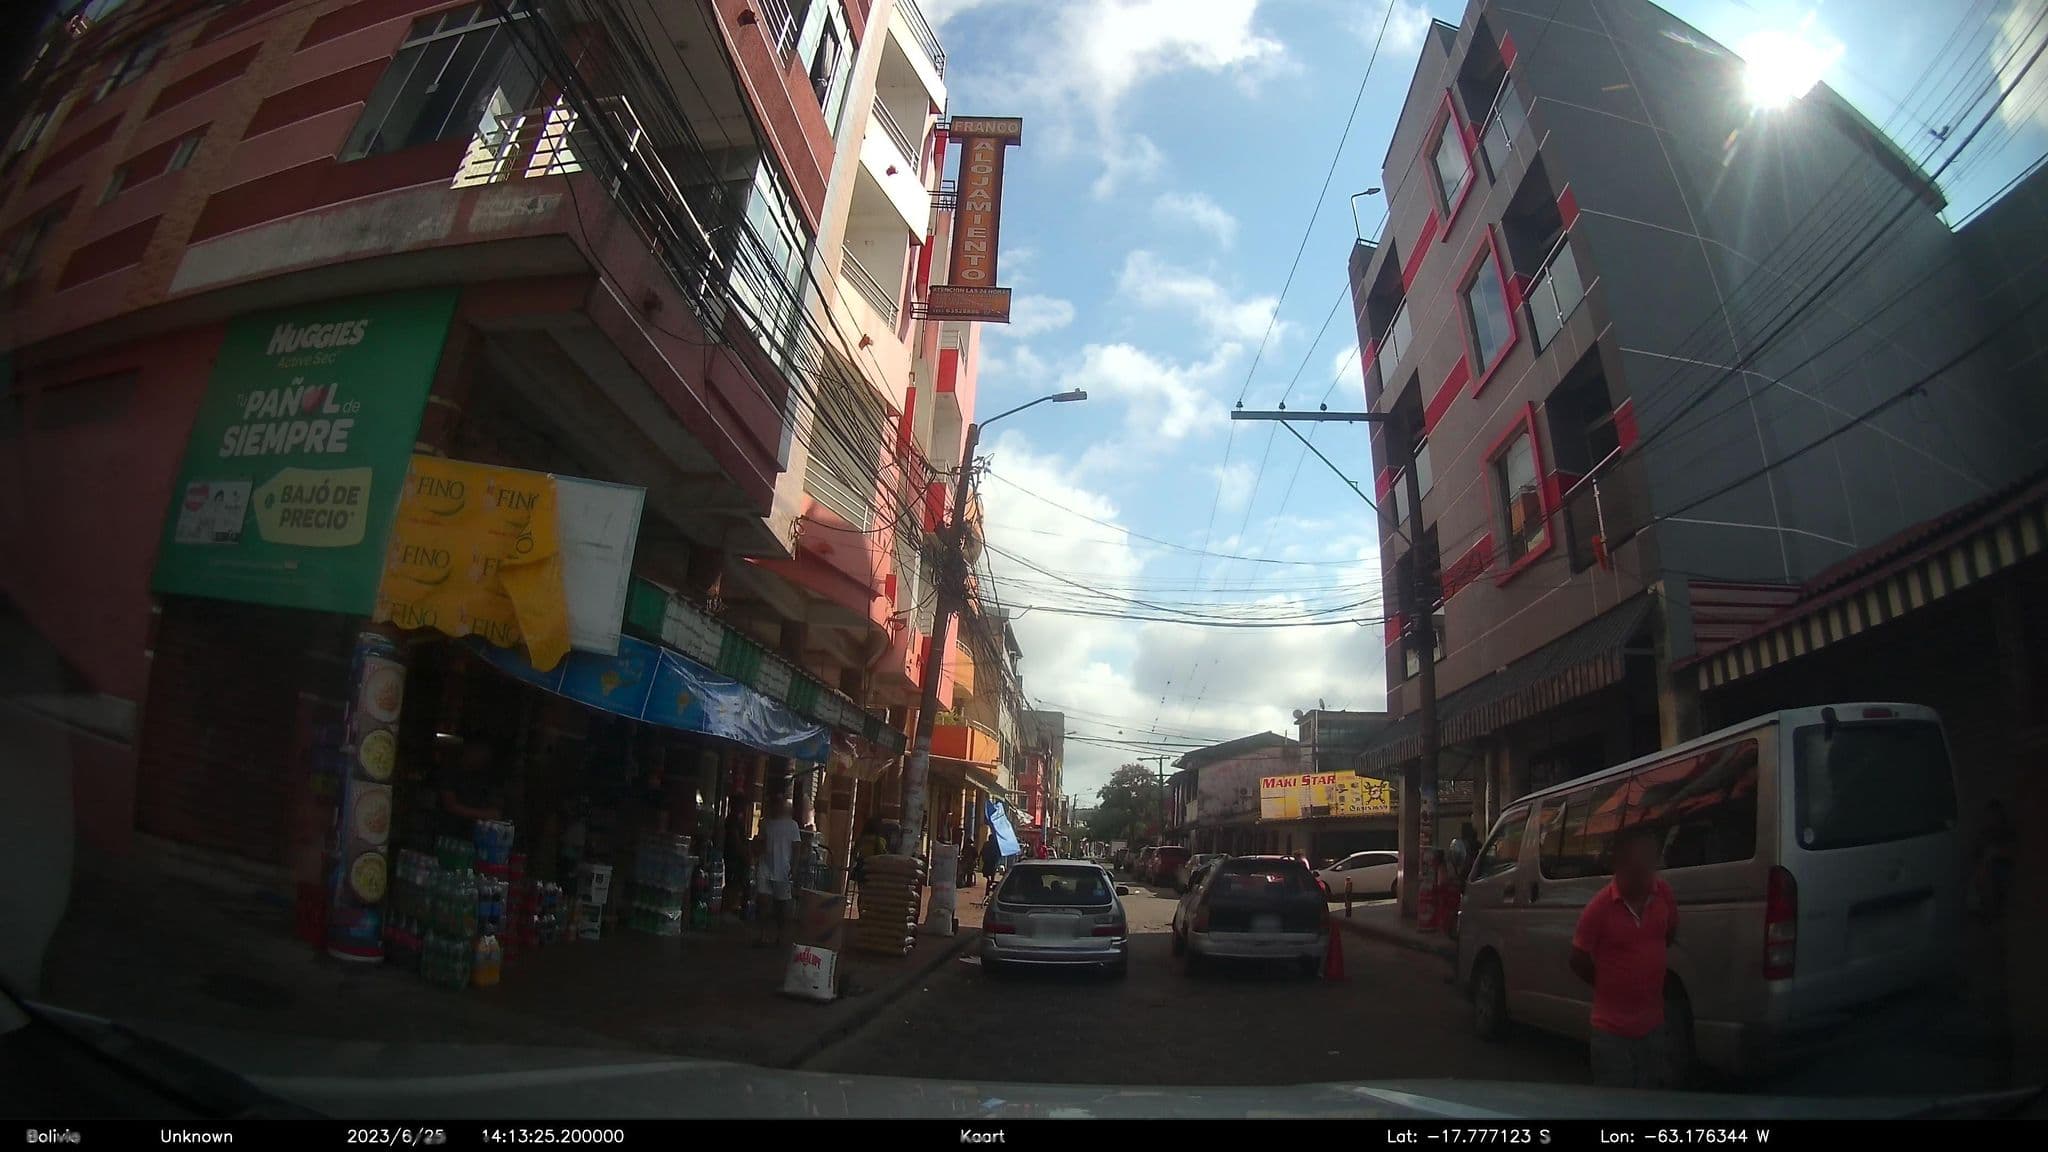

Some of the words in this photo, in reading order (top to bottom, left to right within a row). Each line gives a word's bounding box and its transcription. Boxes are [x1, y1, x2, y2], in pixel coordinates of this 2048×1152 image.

[953, 120, 1019, 134] FRANCO
[961, 140, 994, 280] ALOJAMIENTO
[265, 318, 369, 356] HUGGIES
[342, 398, 361, 414] de
[218, 418, 355, 458] SIEMPRE
[279, 477, 331, 506] BAJÓ
[332, 485, 362, 506] DE
[417, 476, 465, 501] FINO
[279, 508, 351, 531] PRECIO
[402, 545, 451, 569] FINO
[390, 602, 438, 626] FINO
[1262, 776, 1297, 789] MAKI
[1301, 774, 1336, 787] STAR
